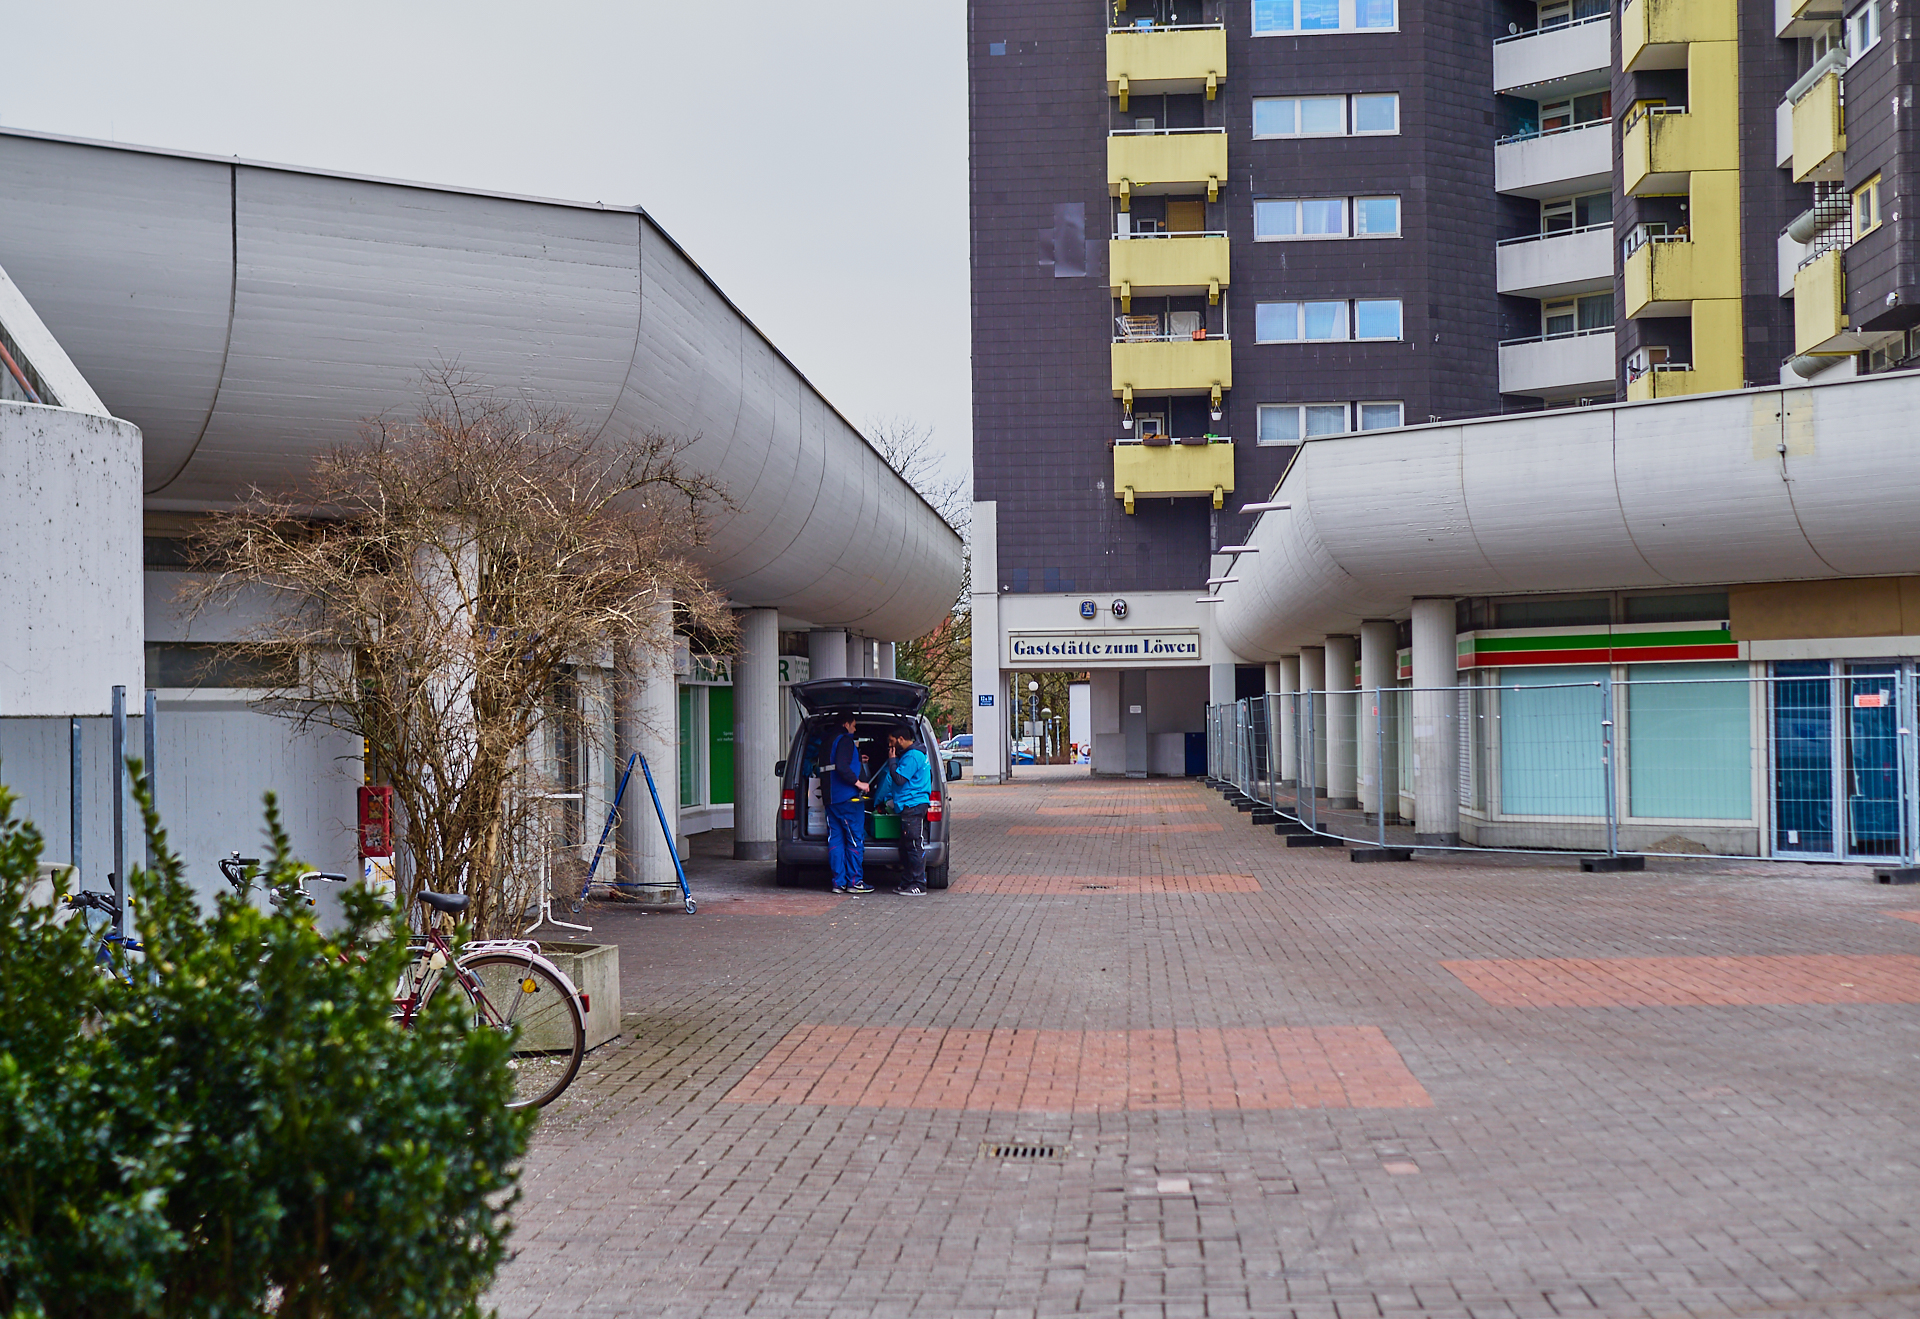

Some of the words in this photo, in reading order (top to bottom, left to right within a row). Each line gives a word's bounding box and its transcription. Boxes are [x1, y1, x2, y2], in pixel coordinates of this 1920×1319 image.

[1014, 640, 1101, 655] Gaststätte
[1104, 644, 1139, 654] zum
[1143, 639, 1196, 654] Löwen
